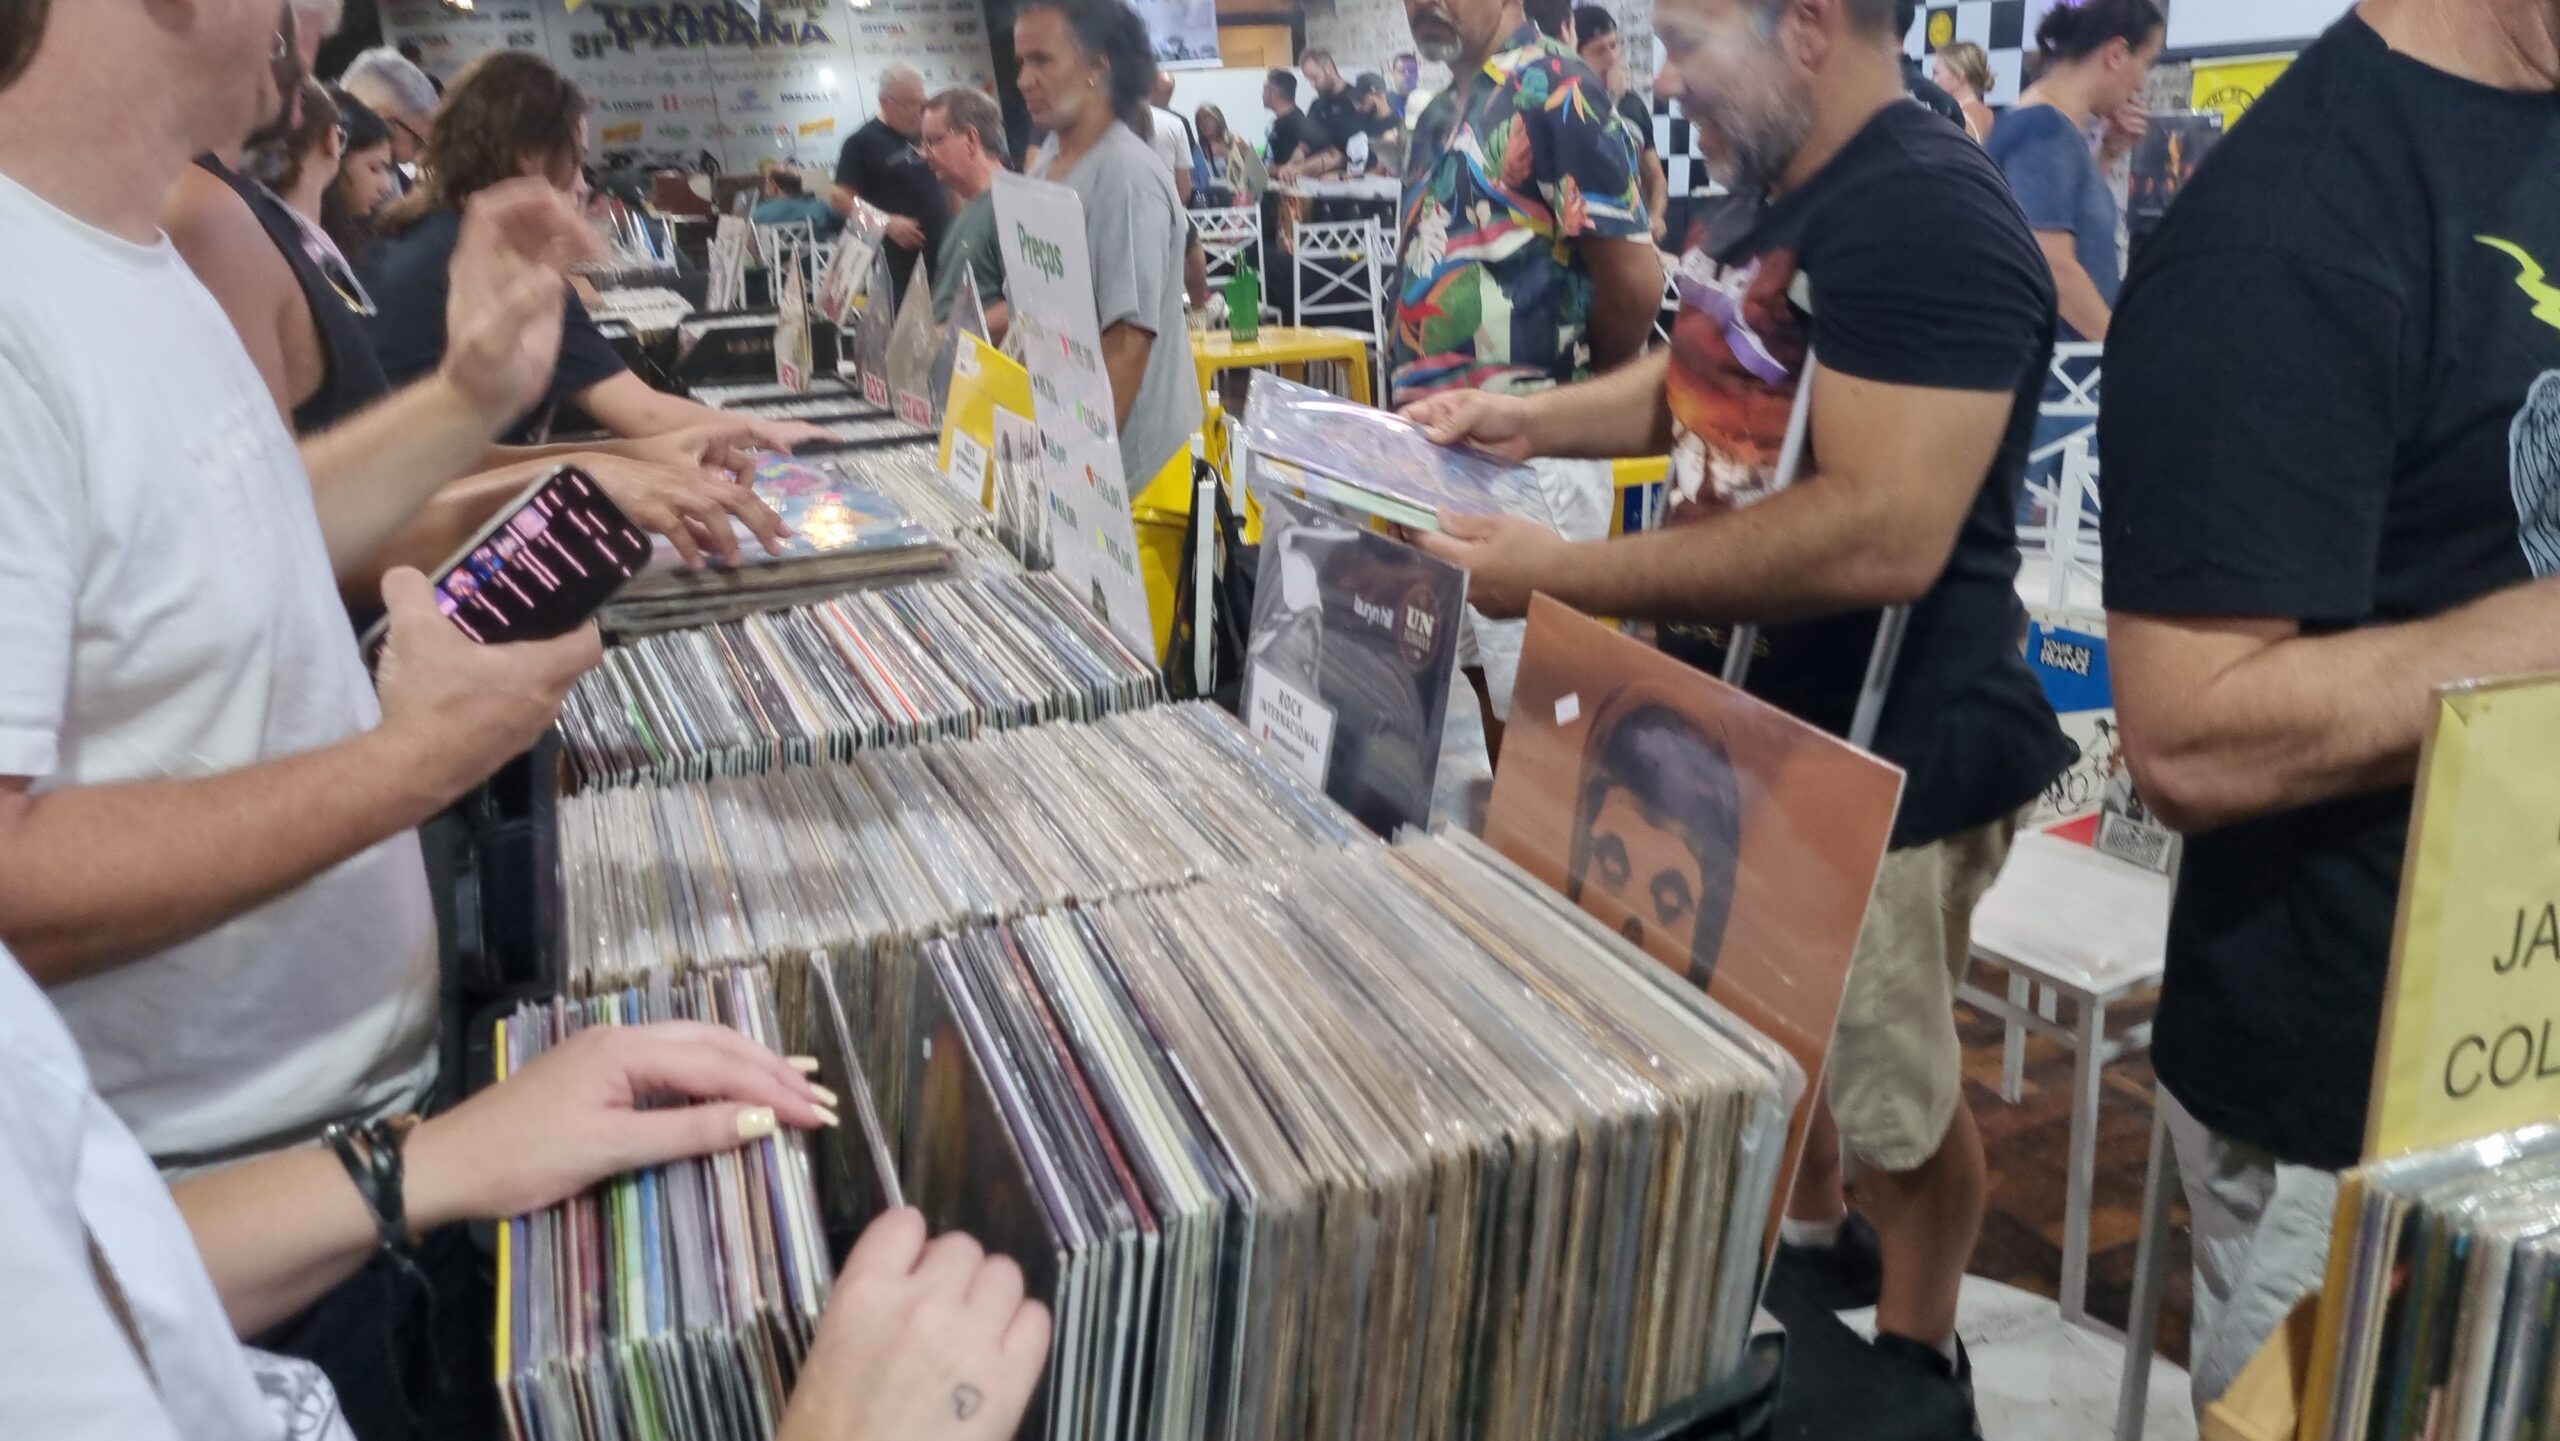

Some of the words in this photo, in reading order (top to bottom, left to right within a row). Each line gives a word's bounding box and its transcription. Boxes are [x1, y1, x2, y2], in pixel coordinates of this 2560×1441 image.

[1016, 220, 1064, 285] Preços
[1406, 603, 1436, 639] UN
[2040, 648, 2089, 676] FRANCE
[2043, 637, 2073, 658] TOUR
[1278, 688, 1304, 720] ROCK
[1258, 695, 1320, 755] INTERNACIONAL
[2443, 1018, 2560, 1100] COL
